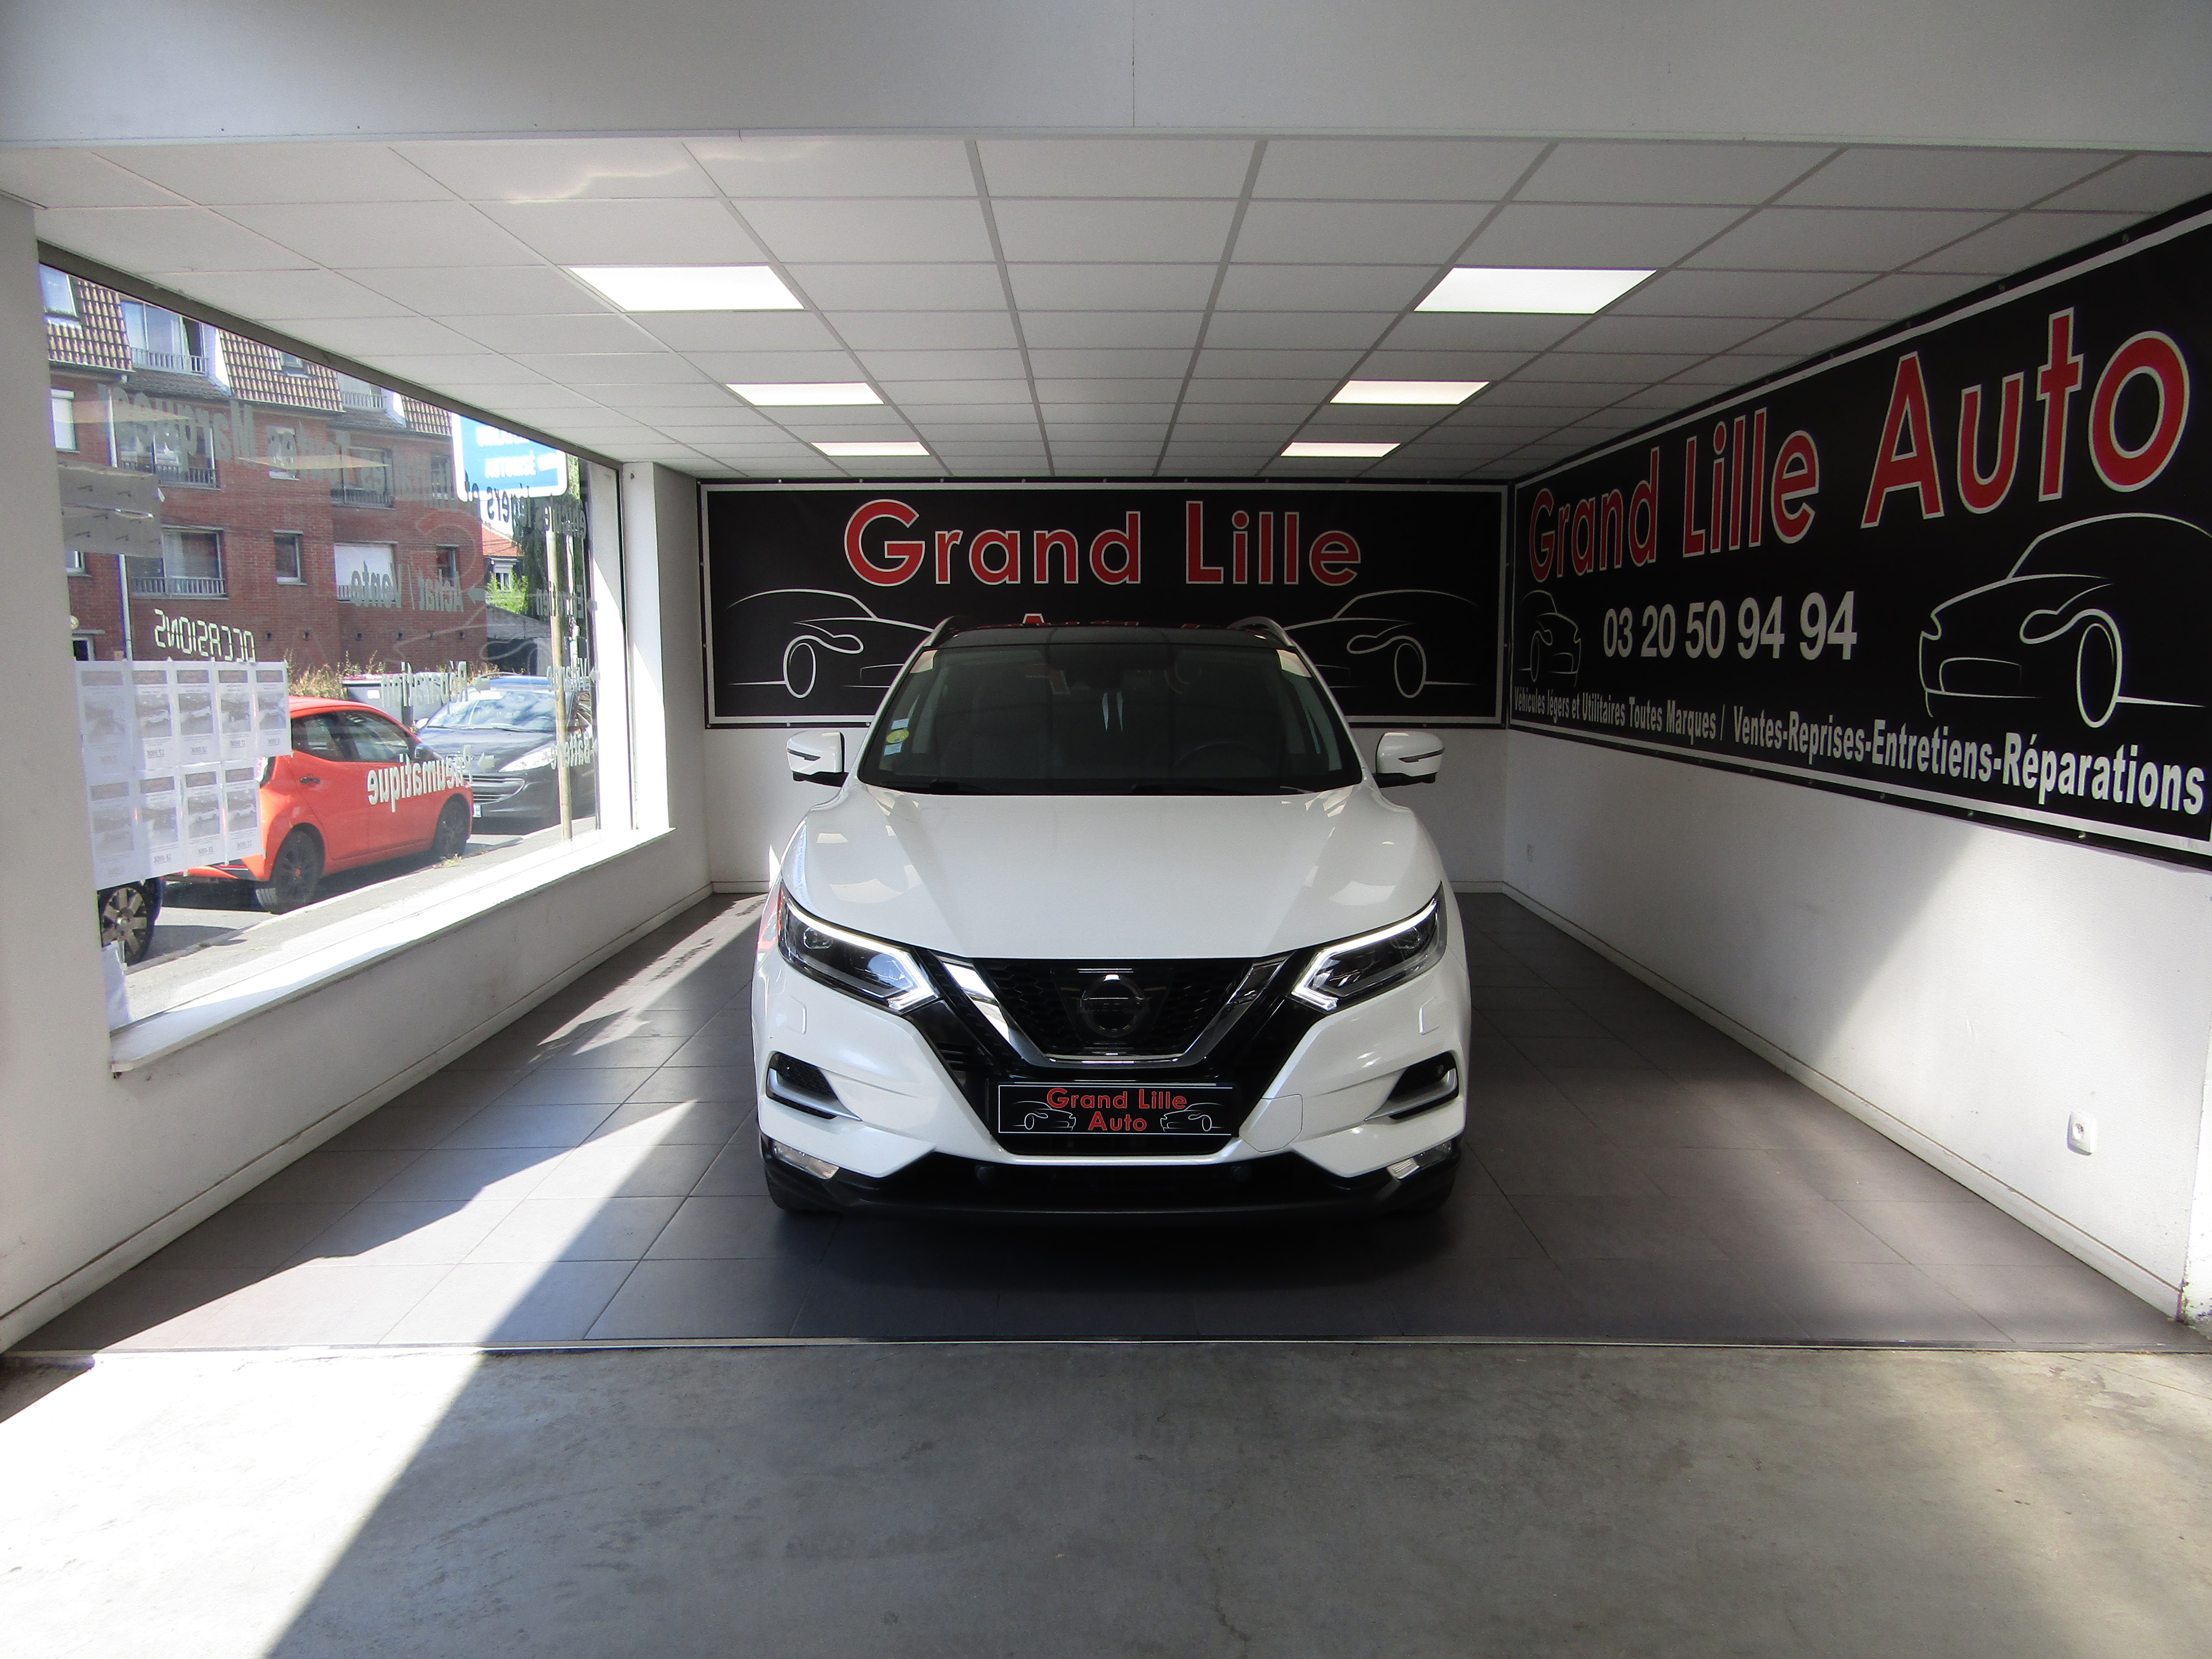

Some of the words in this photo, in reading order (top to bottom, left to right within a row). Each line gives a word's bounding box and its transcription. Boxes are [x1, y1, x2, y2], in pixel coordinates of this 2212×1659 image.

[1529, 446, 1660, 583] Grand
[1683, 406, 1820, 558] Lille
[1860, 307, 2191, 529] Auto
[844, 499, 1141, 587] Grand
[1186, 501, 1361, 586] Lille
[1603, 607, 1633, 658] 03
[1641, 604, 1676, 658] 20
[1685, 600, 1726, 659] 50
[1737, 596, 1785, 659] 94
[1799, 591, 1857, 660] 94
[1515, 687, 1545, 714] Véhicules
[1547, 689, 1569, 723] légers
[1572, 693, 1580, 720] et
[1582, 692, 1625, 726] Utilitaires
[1629, 696, 1662, 732] Toutes
[1666, 699, 1717, 745] Marques
[1720, 704, 1725, 741] /
[1046, 1087, 1128, 1109] Grand
[1139, 1088, 1187, 1109] Lille
[1087, 1111, 1147, 1131] Auto
